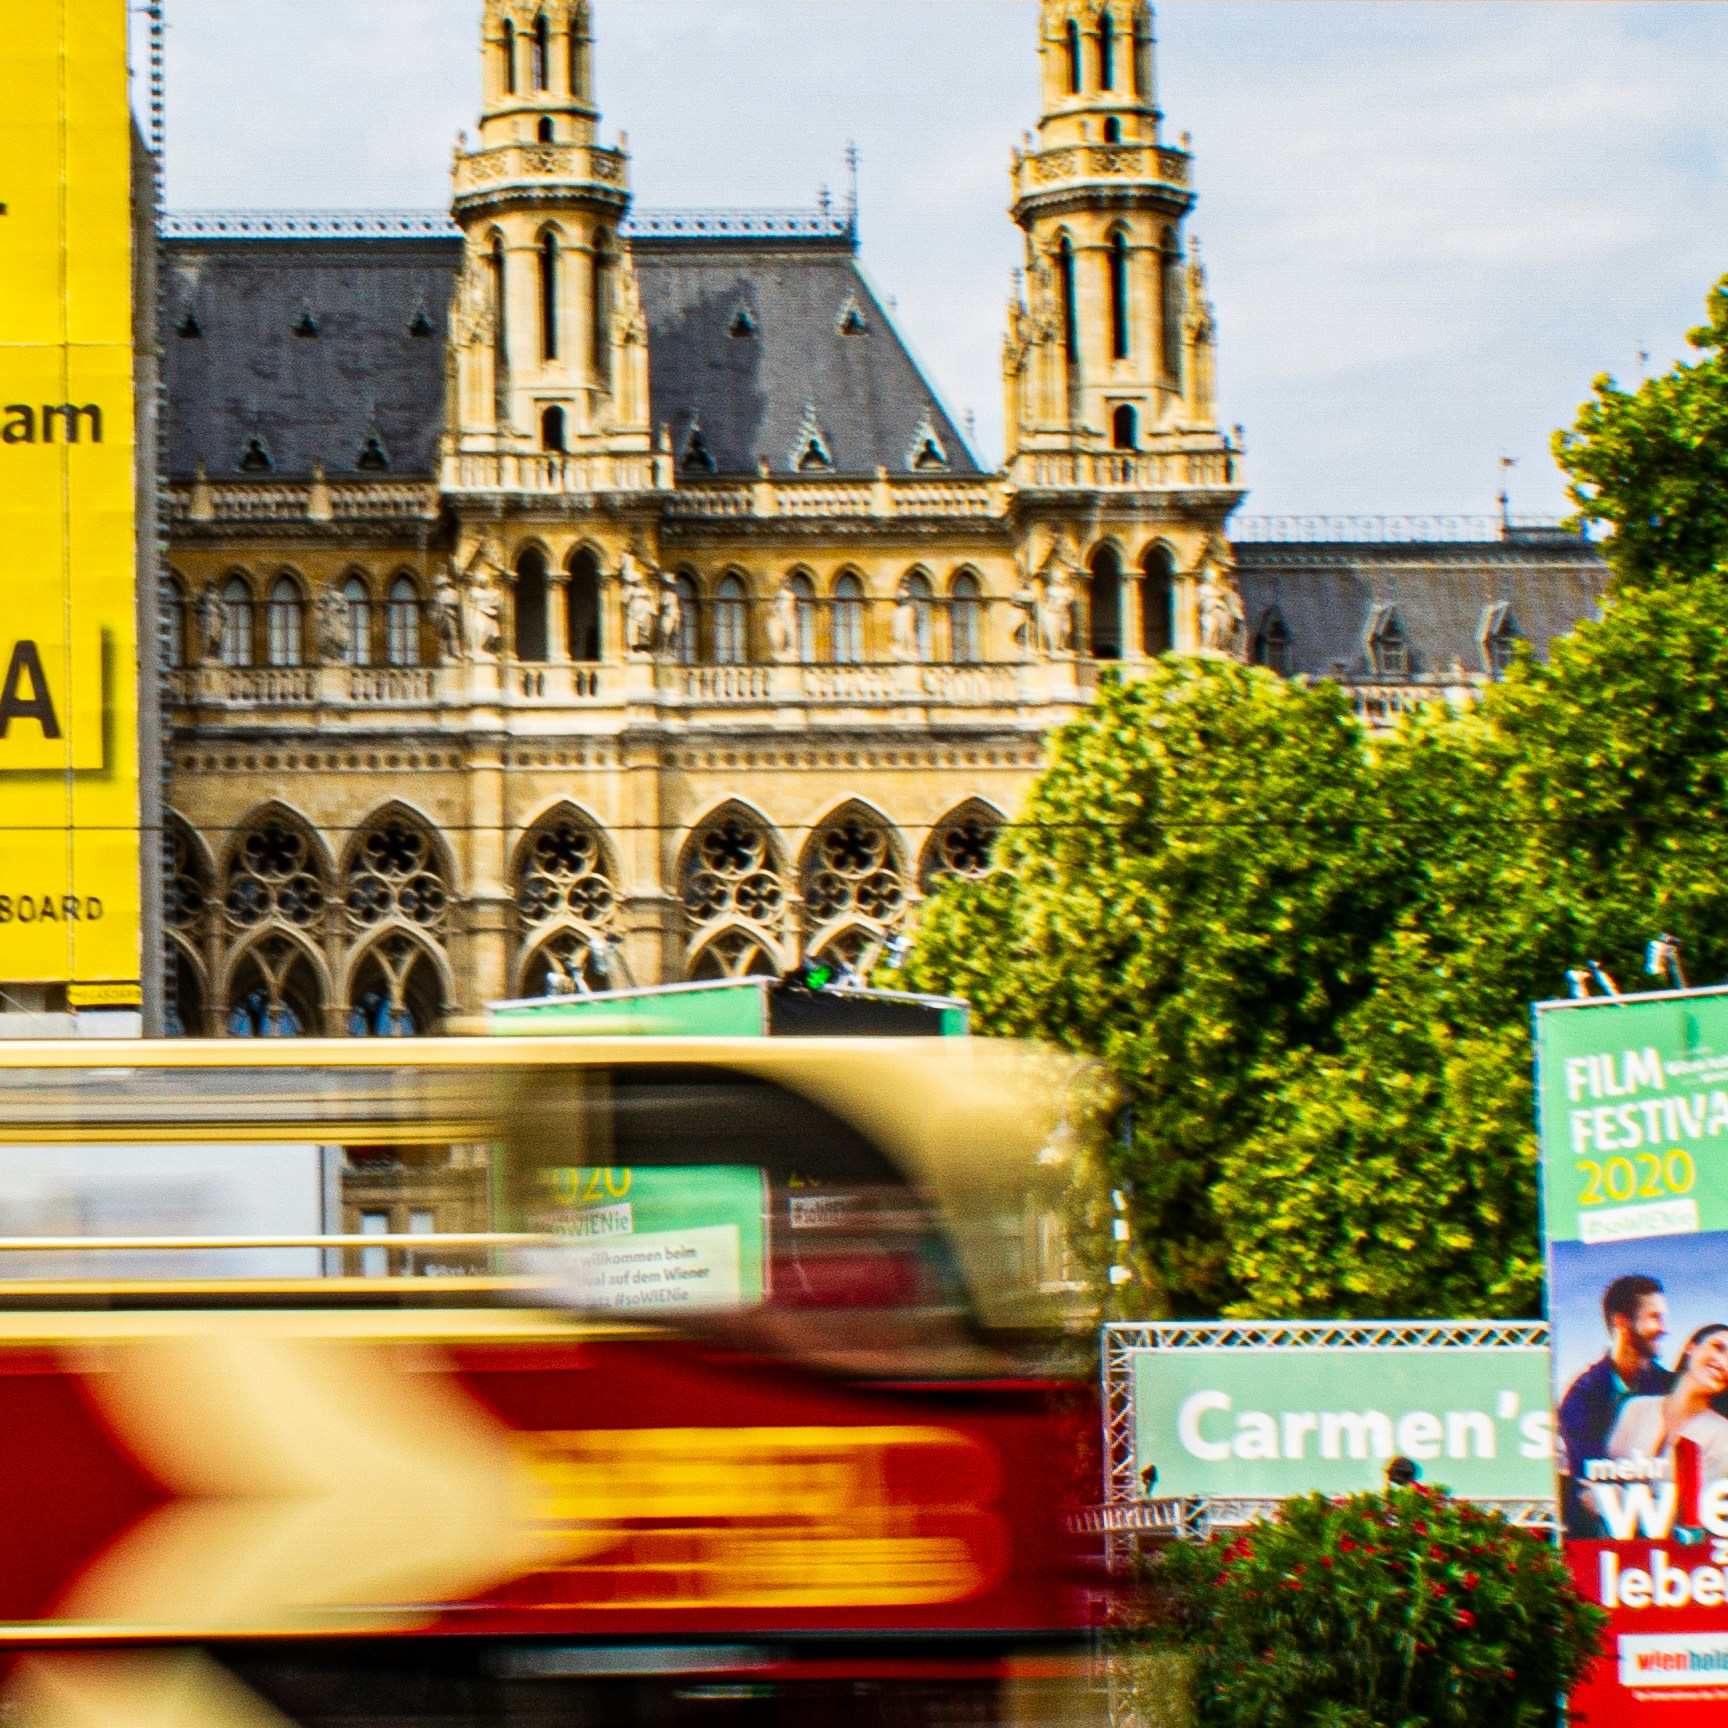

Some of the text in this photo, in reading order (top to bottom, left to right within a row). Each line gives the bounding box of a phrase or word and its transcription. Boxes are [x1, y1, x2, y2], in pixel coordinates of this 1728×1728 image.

[1566, 1047, 1666, 1102] FILM
[1570, 1091, 1728, 1154] FESTIVA
[1575, 1149, 1696, 1205] 2020
[1177, 1389, 1559, 1461] Carmen's
[1583, 1449, 1670, 1482] mehr
[1598, 1549, 1728, 1609] lebe
